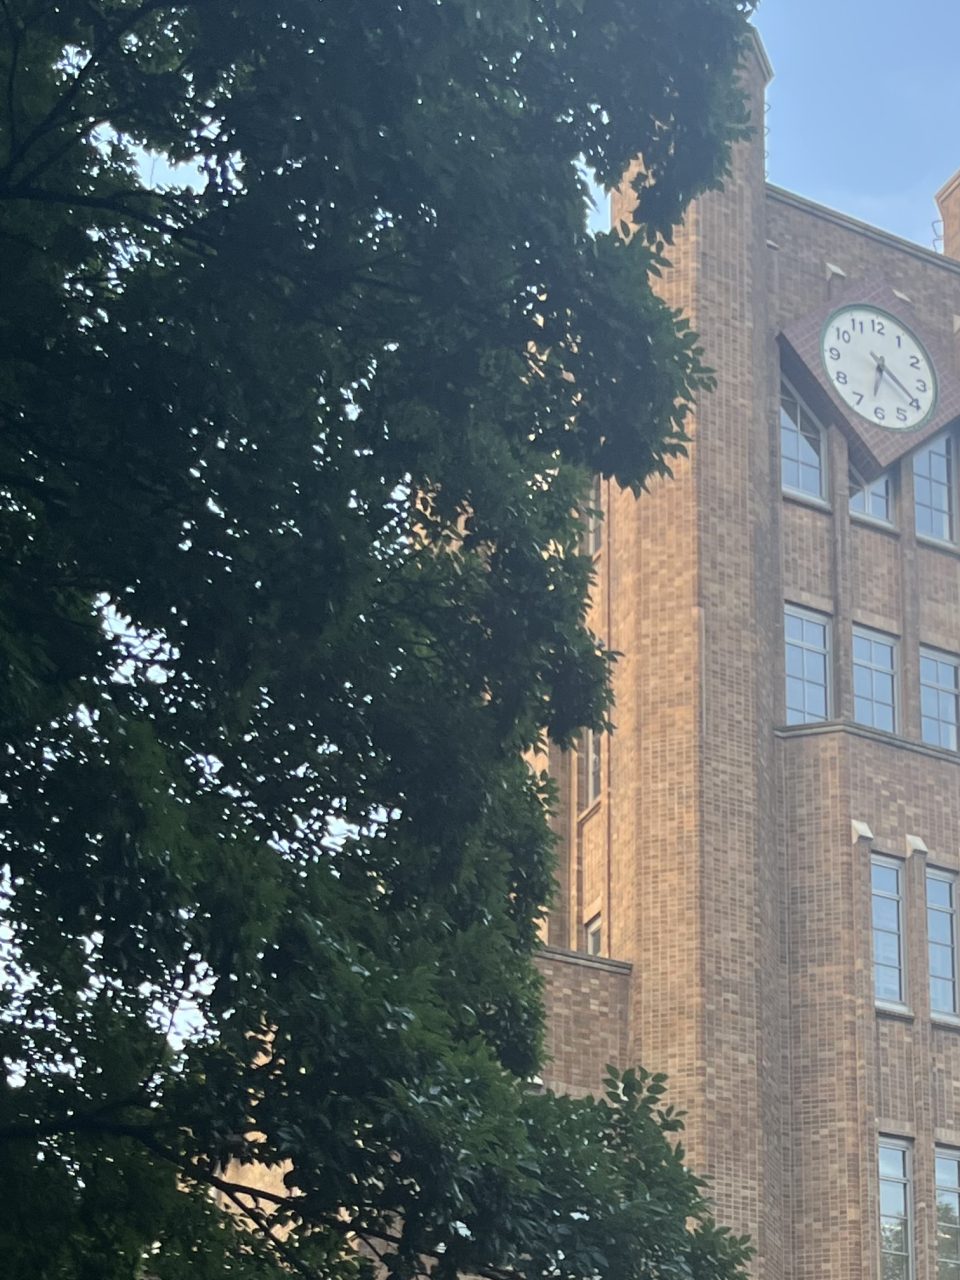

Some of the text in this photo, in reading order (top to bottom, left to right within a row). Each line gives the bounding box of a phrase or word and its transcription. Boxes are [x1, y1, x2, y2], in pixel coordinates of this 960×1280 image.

[851, 318, 864, 334] 11
[871, 319, 885, 336] 12
[836, 327, 851, 344] 10
[896, 335, 901, 348] 1
[829, 347, 841, 361] 9
[909, 355, 920, 370] 2
[836, 371, 848, 385] 8
[916, 379, 927, 393] 3
[852, 391, 864, 406] 7
[909, 398, 921, 411] 4
[874, 407, 885, 421] 6
[896, 407, 907, 422] 5
